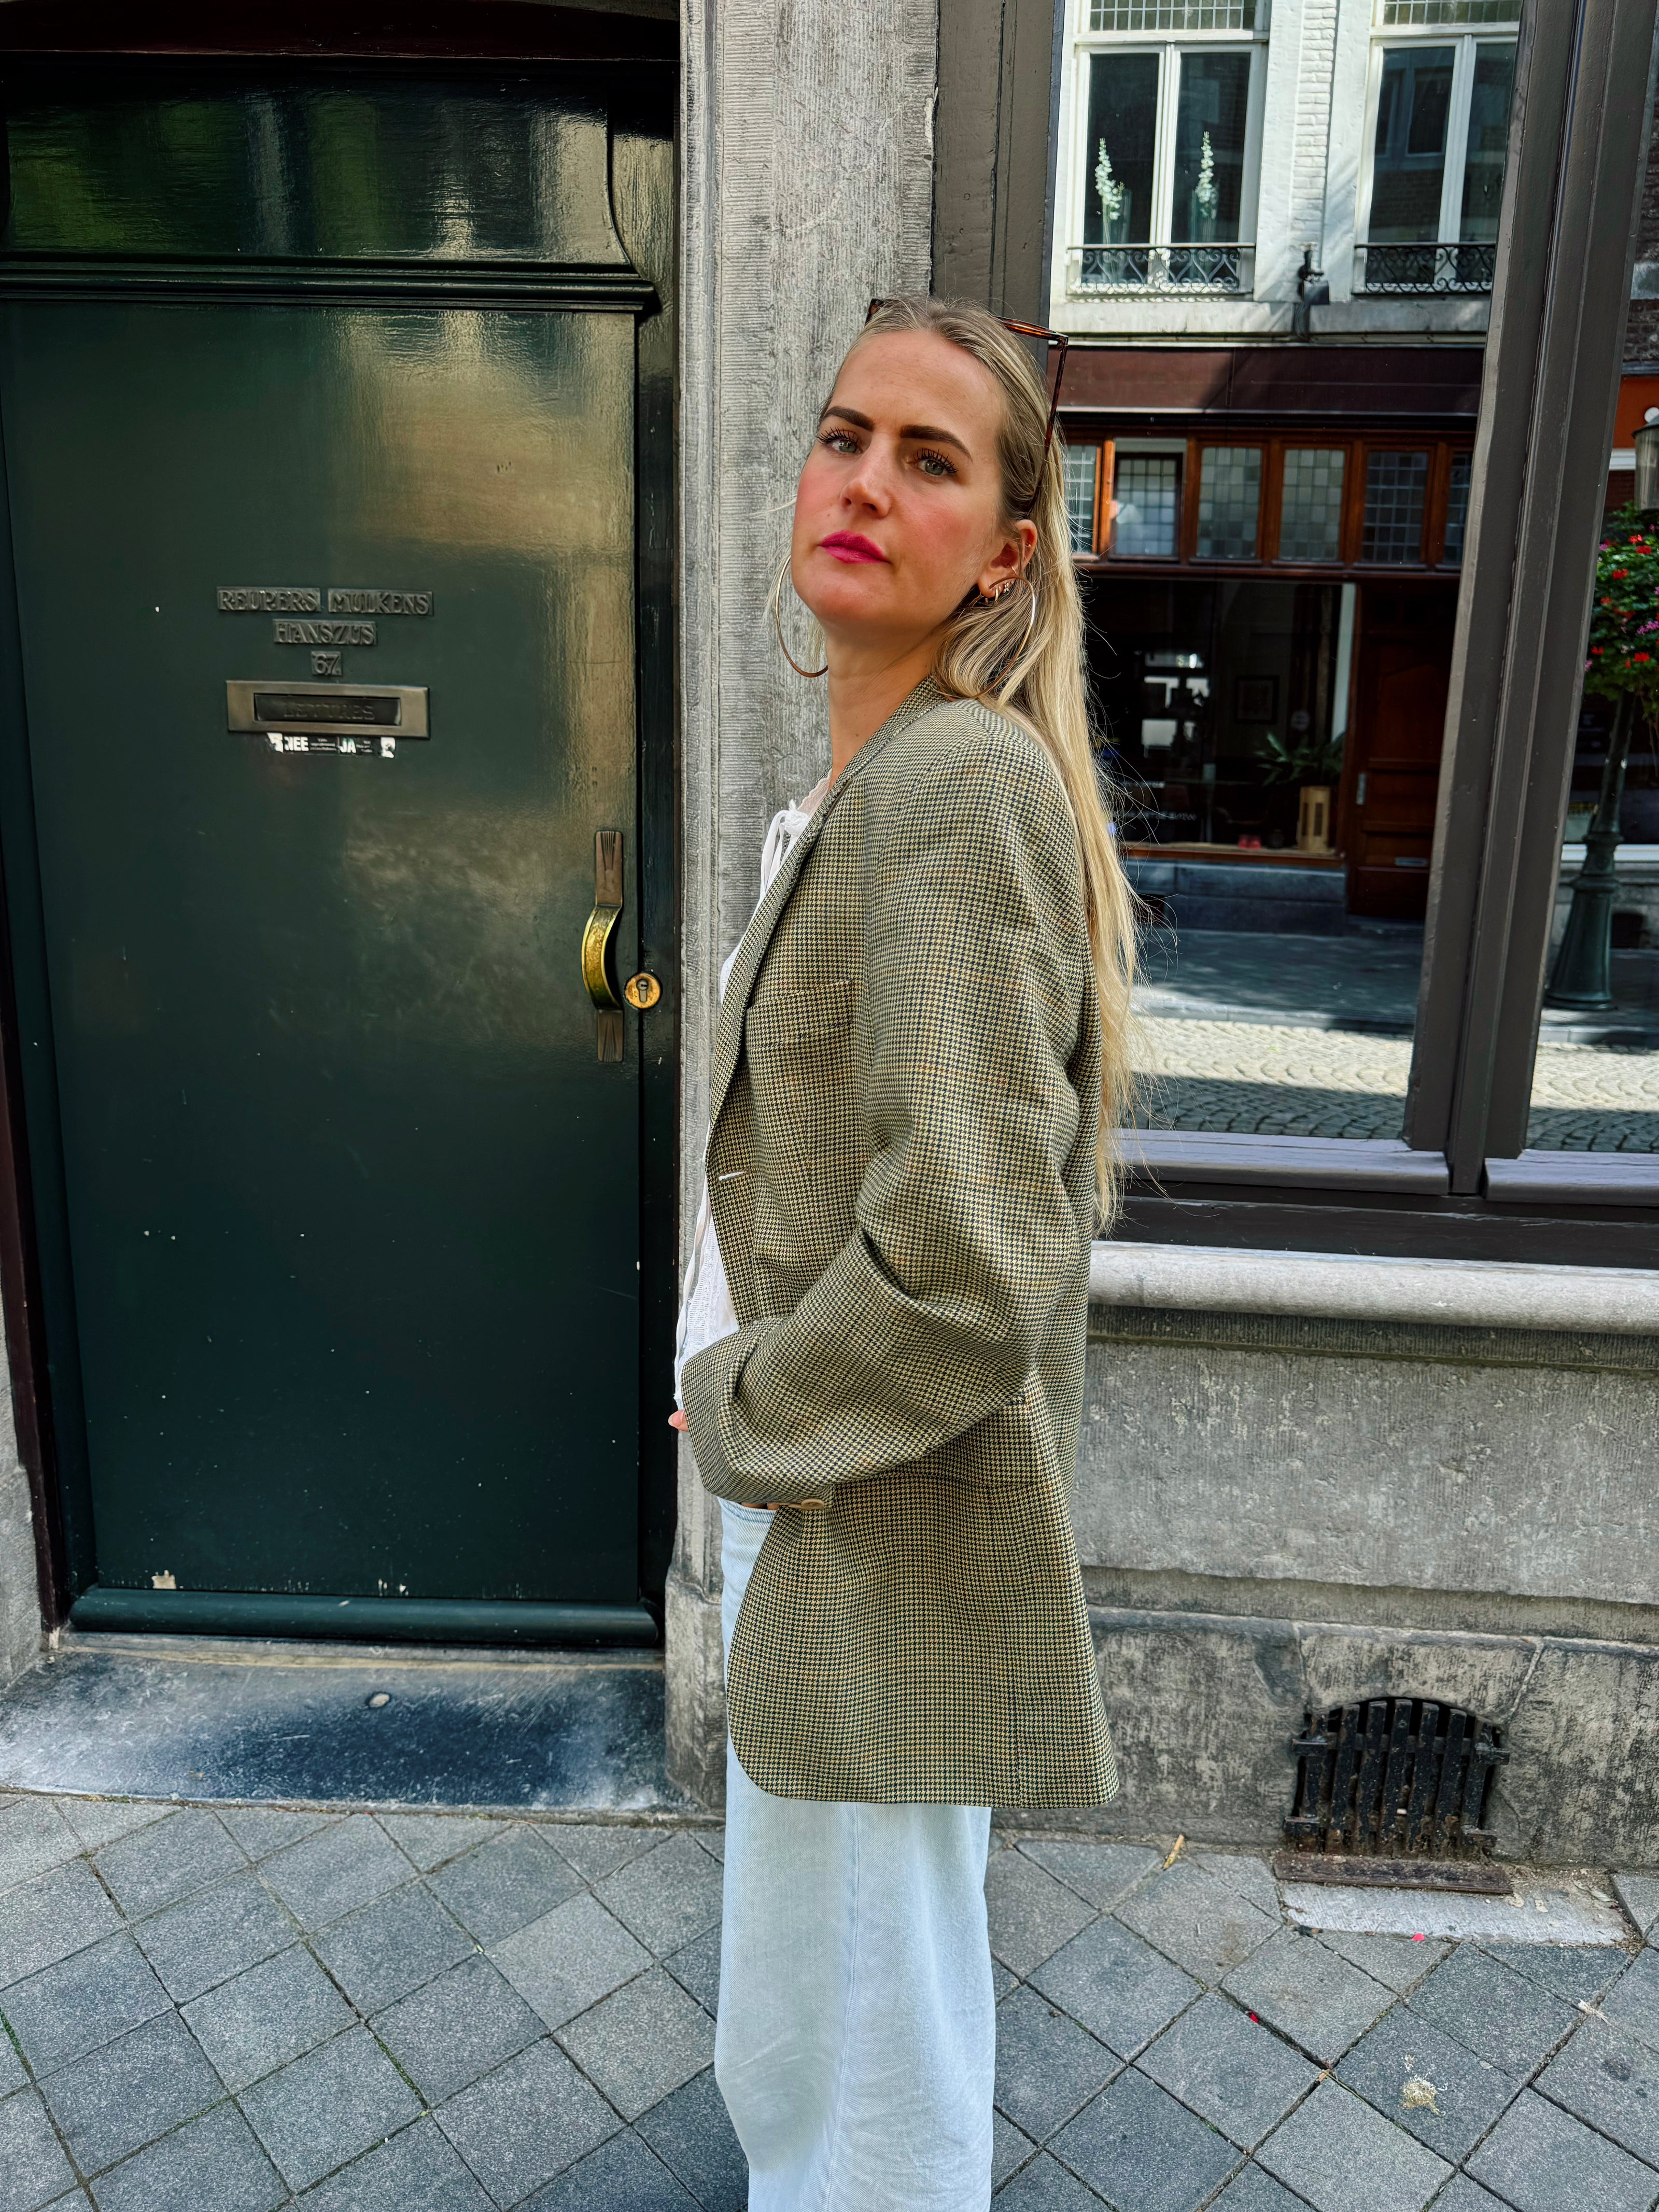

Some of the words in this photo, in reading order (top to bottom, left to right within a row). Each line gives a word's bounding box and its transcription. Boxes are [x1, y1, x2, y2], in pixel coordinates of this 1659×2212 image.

[219, 590, 318, 612] REUPERS
[332, 592, 429, 615] MULKENS
[275, 623, 374, 645] HANSZUS
[284, 736, 309, 752] NEE
[340, 738, 356, 753] JA
